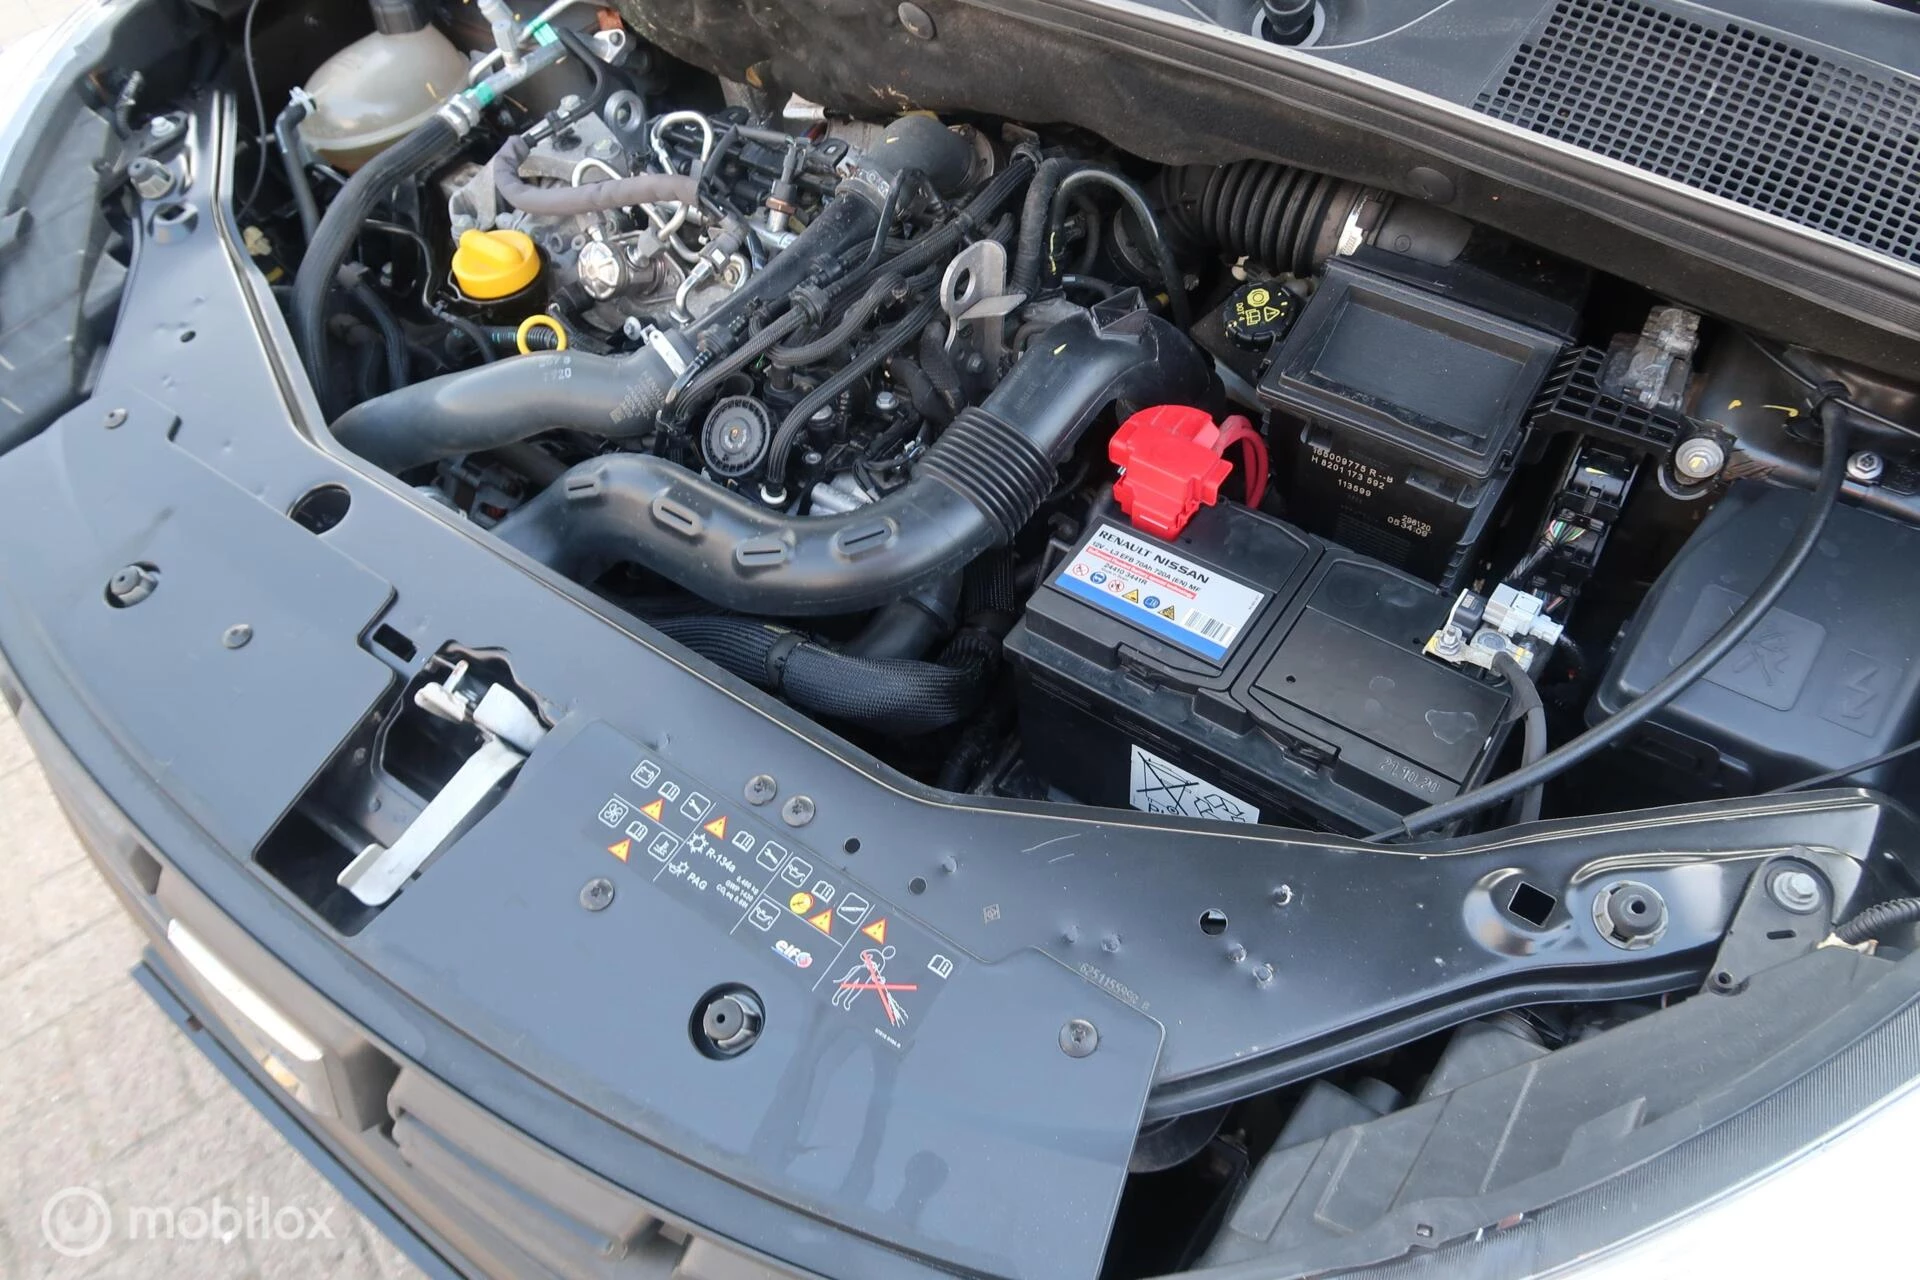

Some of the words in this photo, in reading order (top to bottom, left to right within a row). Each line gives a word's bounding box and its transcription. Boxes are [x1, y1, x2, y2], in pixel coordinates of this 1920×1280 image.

[1236, 302, 1245, 315] DOT
[1311, 455, 1318, 464] H
[1321, 459, 1345, 474] 8201
[1347, 469, 1364, 481] 173
[1092, 541, 1105, 549] 12V
[1110, 548, 1120, 556] L3
[1120, 553, 1134, 562] EFB
[1135, 560, 1153, 571] 70Ah
[1154, 568, 1171, 579] 720A
[1172, 576, 1188, 588] (EN)
[1189, 583, 1201, 592] MF
[1098, 530, 1150, 557] RENAULT
[1153, 554, 1210, 584] NISSAN
[1104, 563, 1125, 575] 24410
[706, 847, 736, 873] R-134a
[687, 872, 708, 890] PAG
[775, 940, 801, 959] elf
